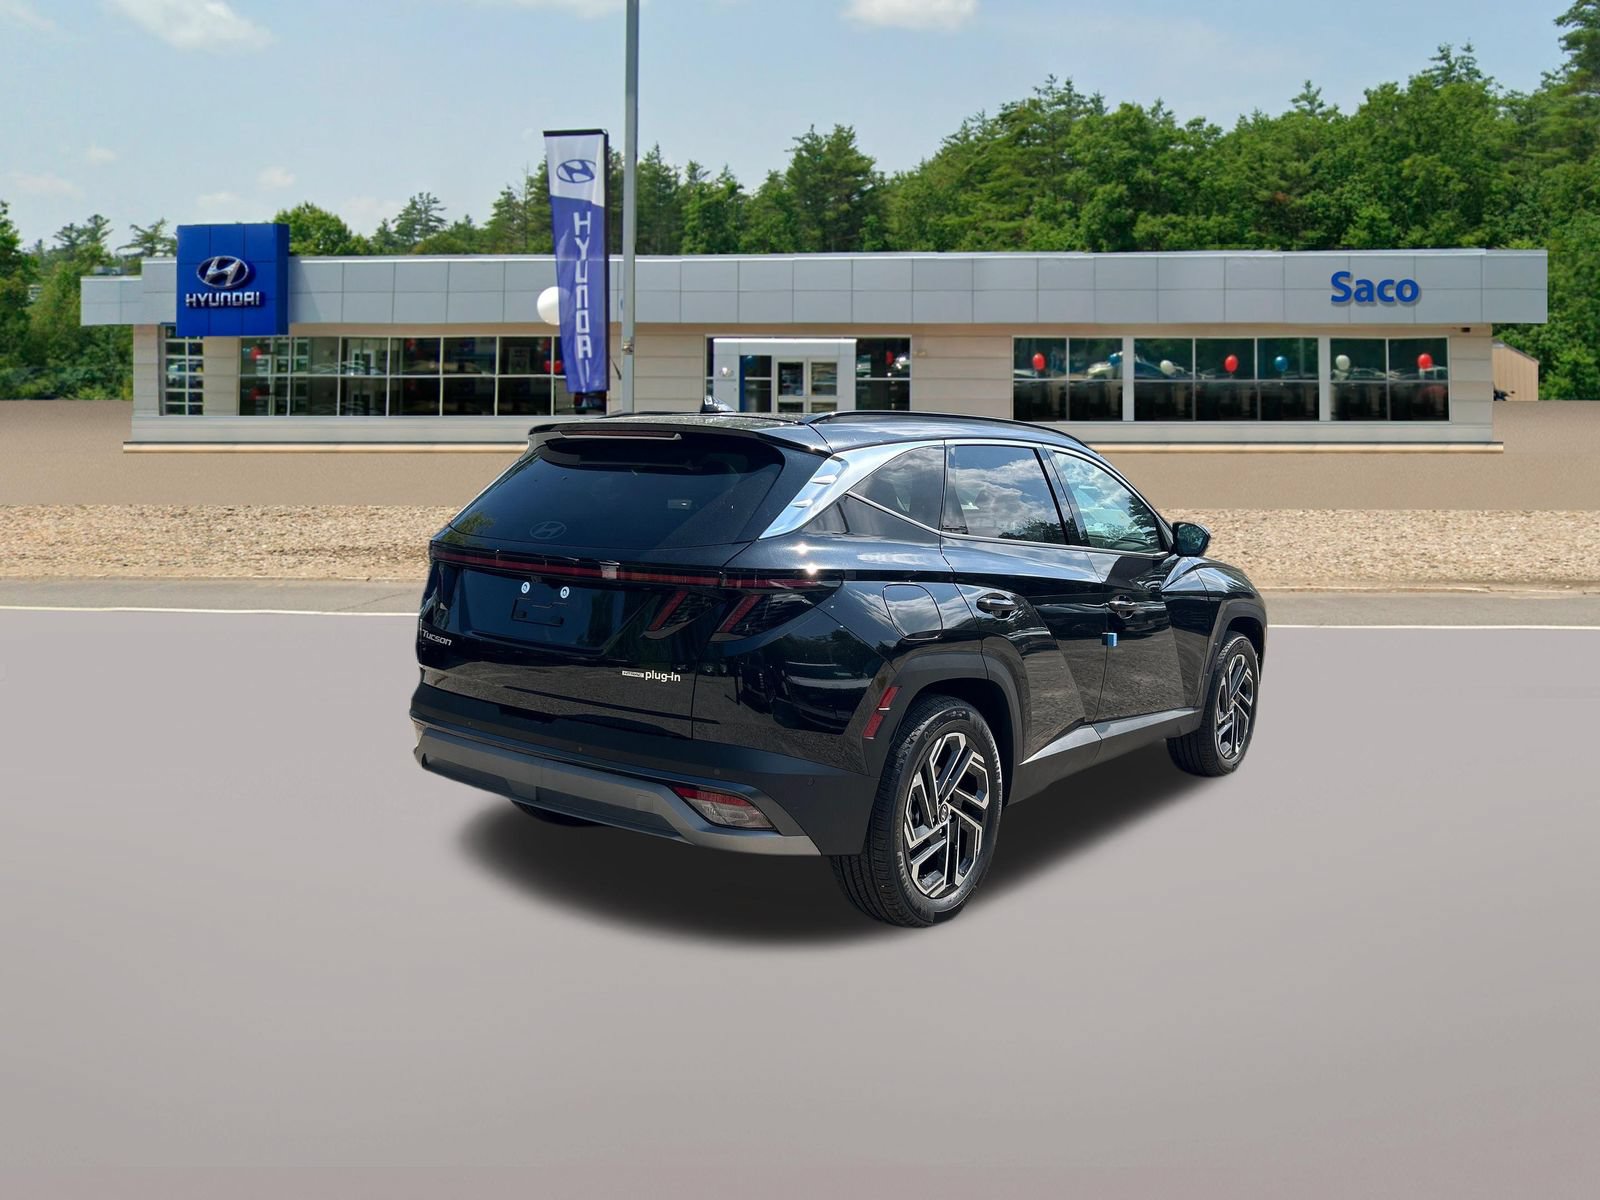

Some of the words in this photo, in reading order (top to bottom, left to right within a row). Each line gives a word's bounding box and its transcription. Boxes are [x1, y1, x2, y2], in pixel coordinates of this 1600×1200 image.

[1330, 270, 1420, 303] Saco
[185, 291, 260, 308] HYUNDAI
[573, 211, 593, 383] HYUNDAI
[421, 629, 453, 646] Tucson
[645, 669, 681, 683] plug-in
